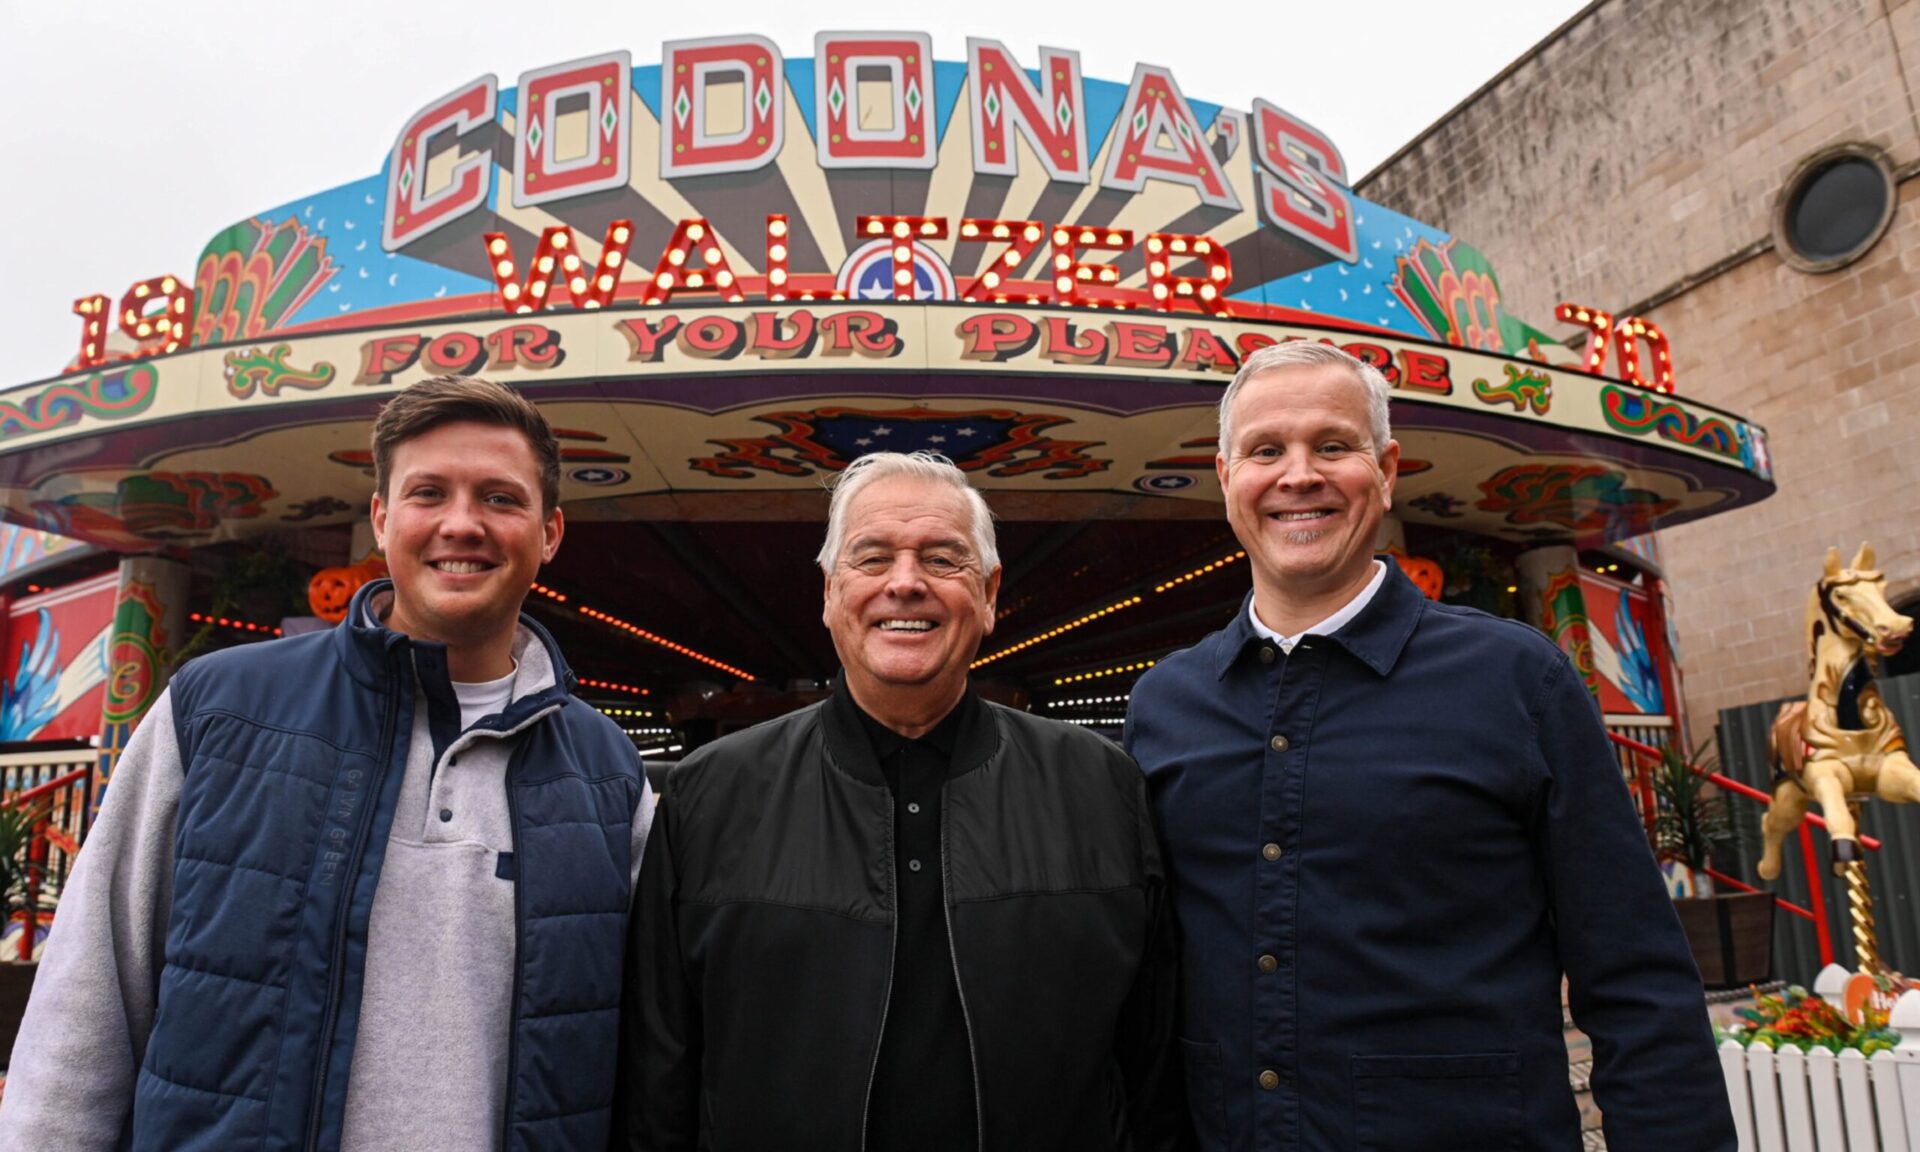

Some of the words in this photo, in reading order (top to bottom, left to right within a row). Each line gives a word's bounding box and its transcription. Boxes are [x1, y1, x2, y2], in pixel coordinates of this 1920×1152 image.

[381, 30, 1359, 264] CODONA'S
[483, 213, 1235, 318] WALTZER
[62, 274, 195, 374] 19
[354, 323, 565, 386] FOR
[612, 309, 904, 363] YOUR
[1555, 303, 1676, 394] 70
[337, 768, 364, 822] GALVIN
